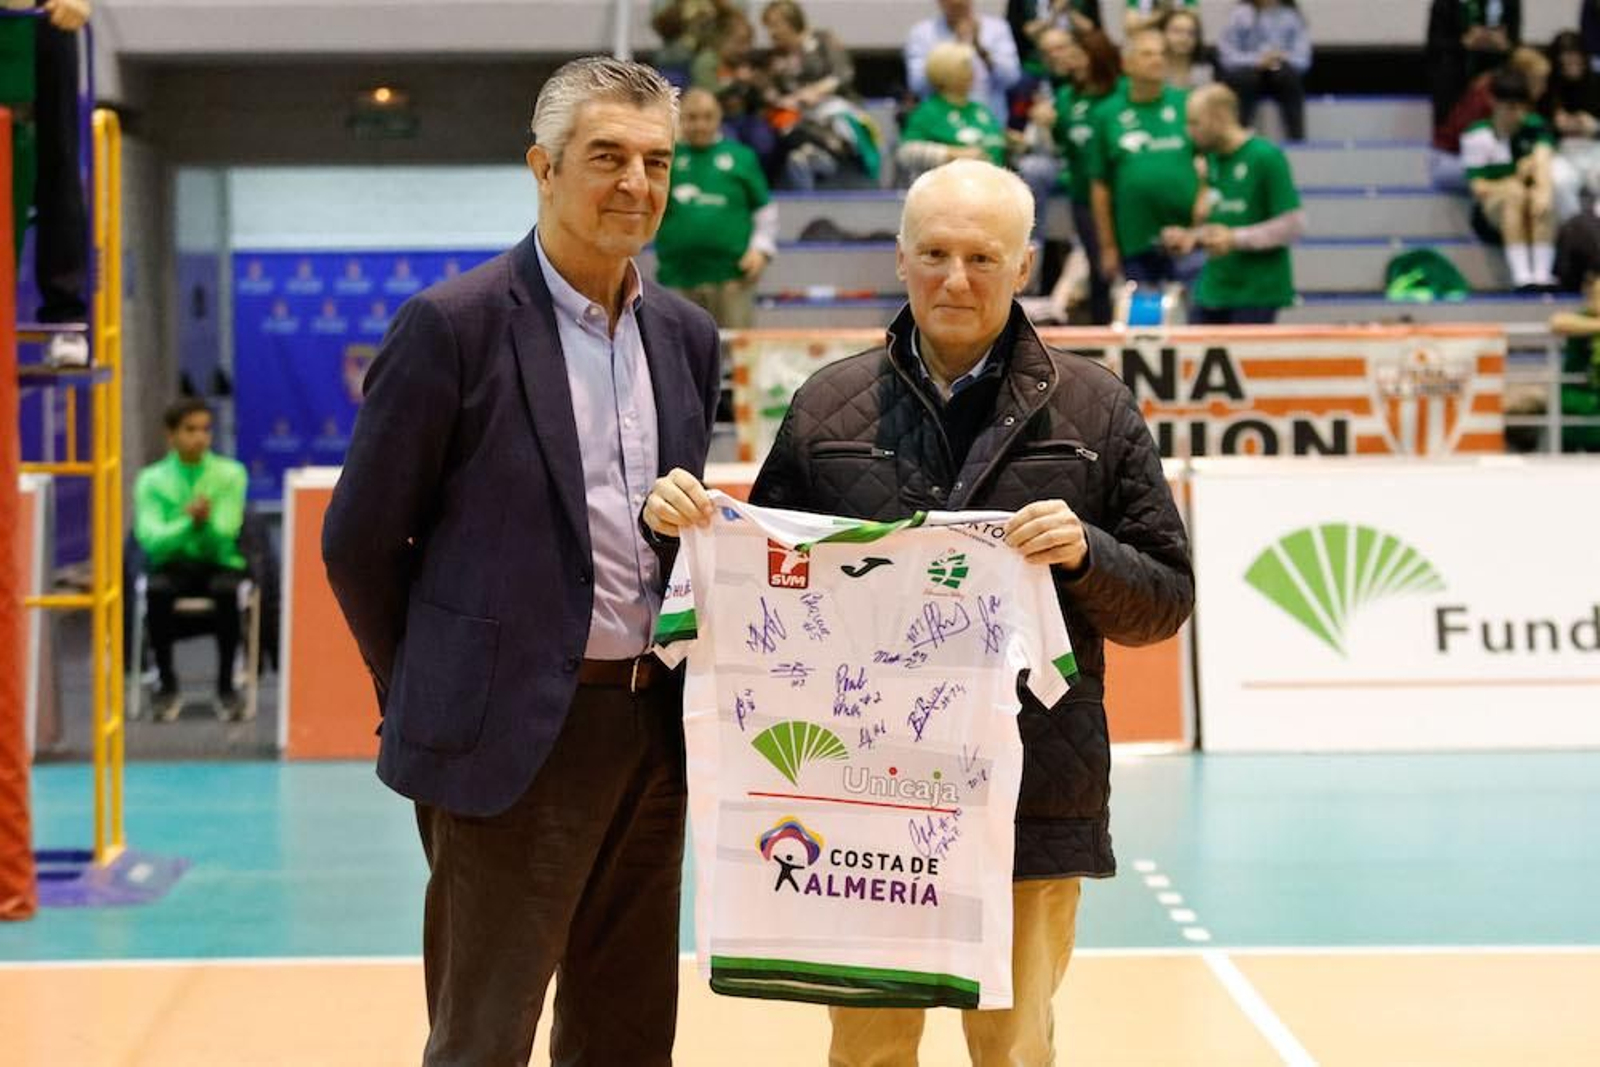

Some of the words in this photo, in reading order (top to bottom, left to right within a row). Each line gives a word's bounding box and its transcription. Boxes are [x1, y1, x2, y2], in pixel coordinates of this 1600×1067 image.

[1076, 334, 1246, 401] ÑA
[1157, 418, 1348, 456] ION
[770, 573, 807, 588] SVM
[1435, 604, 1600, 653] Fund
[843, 765, 960, 808] Unicaja
[829, 849, 905, 873] COSTA
[911, 856, 939, 875] DE
[803, 872, 939, 908] ALMERÍA
